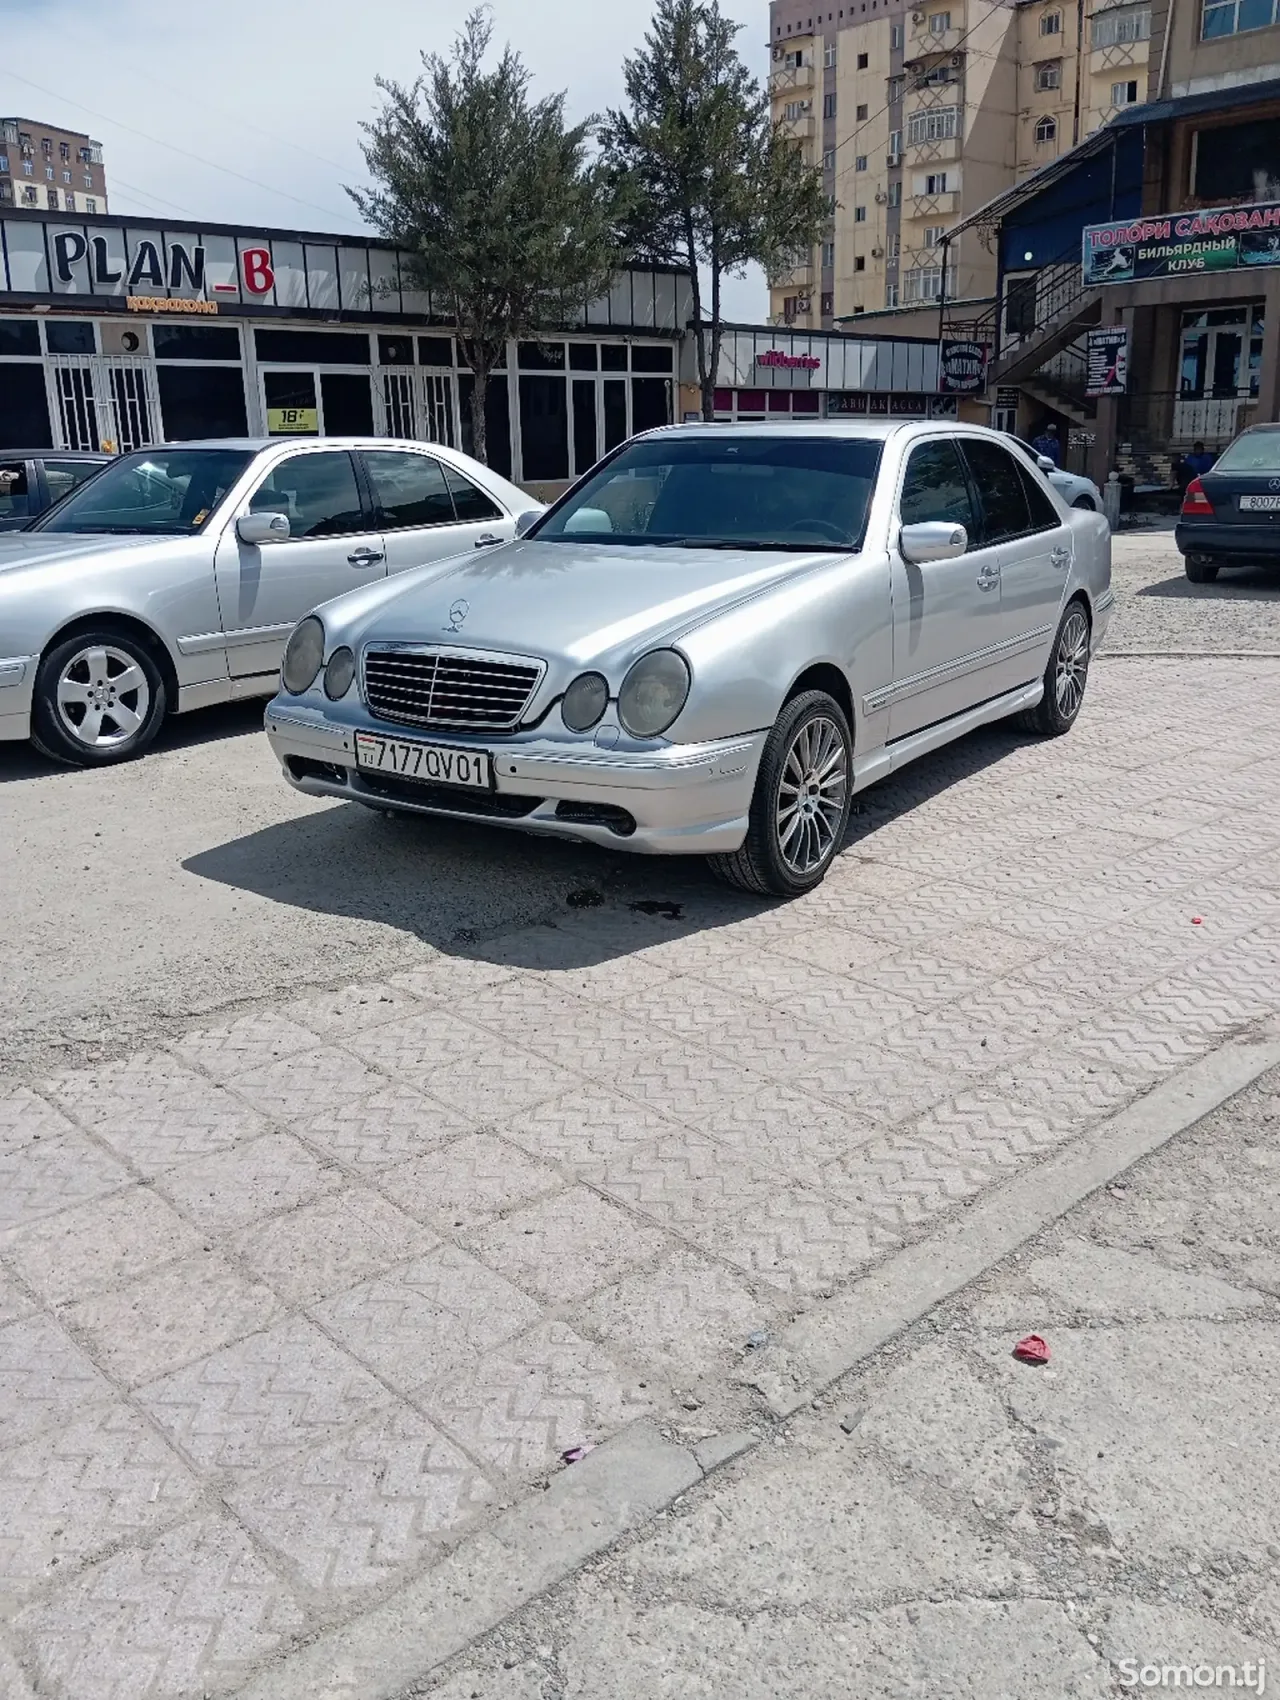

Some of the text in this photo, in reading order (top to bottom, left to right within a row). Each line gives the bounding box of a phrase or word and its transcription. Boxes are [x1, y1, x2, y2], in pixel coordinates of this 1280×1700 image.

[1088, 220, 1171, 248] ТОЛОРИ
[1138, 236, 1236, 259] БИЛЬЯРДНЫЙ
[1168, 257, 1206, 272] КЛУБ
[281, 409, 305, 423] 18+
[376, 741, 482, 784] 7177QV01
